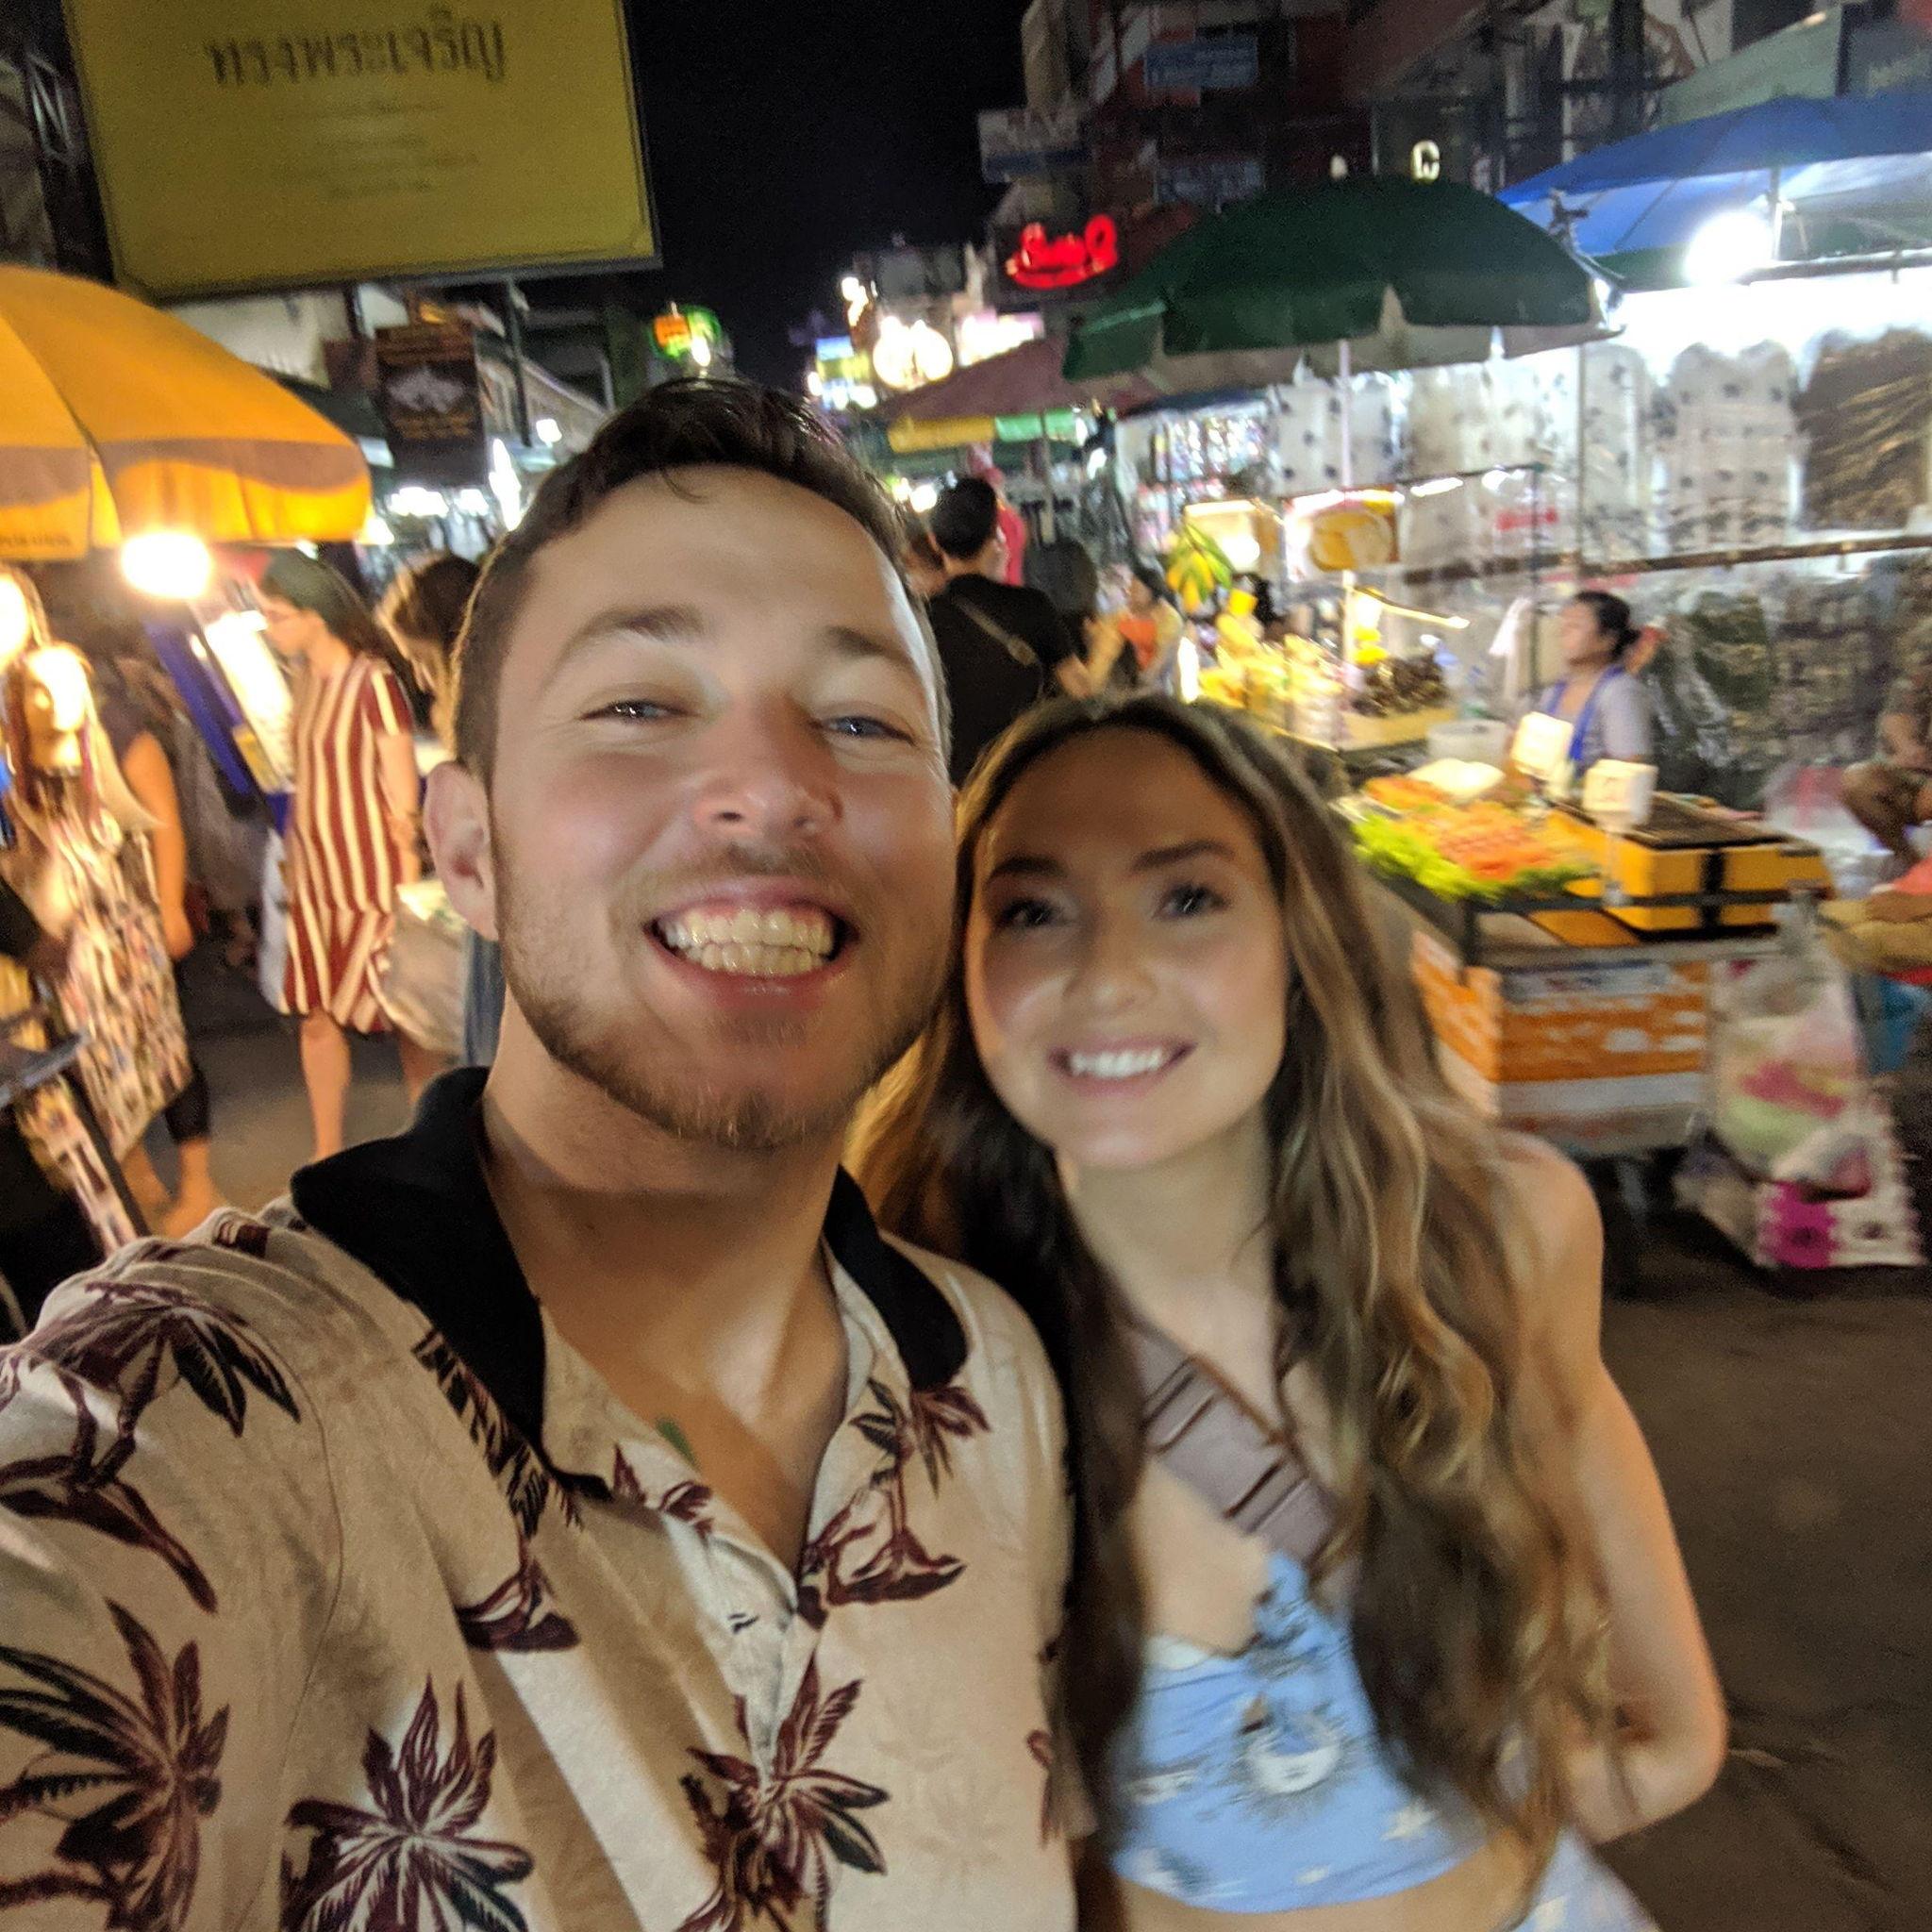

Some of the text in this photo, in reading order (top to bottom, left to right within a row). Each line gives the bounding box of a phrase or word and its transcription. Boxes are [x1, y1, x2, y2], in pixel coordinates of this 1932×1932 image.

[204, 4, 506, 85] ทรงพระเจริญ
